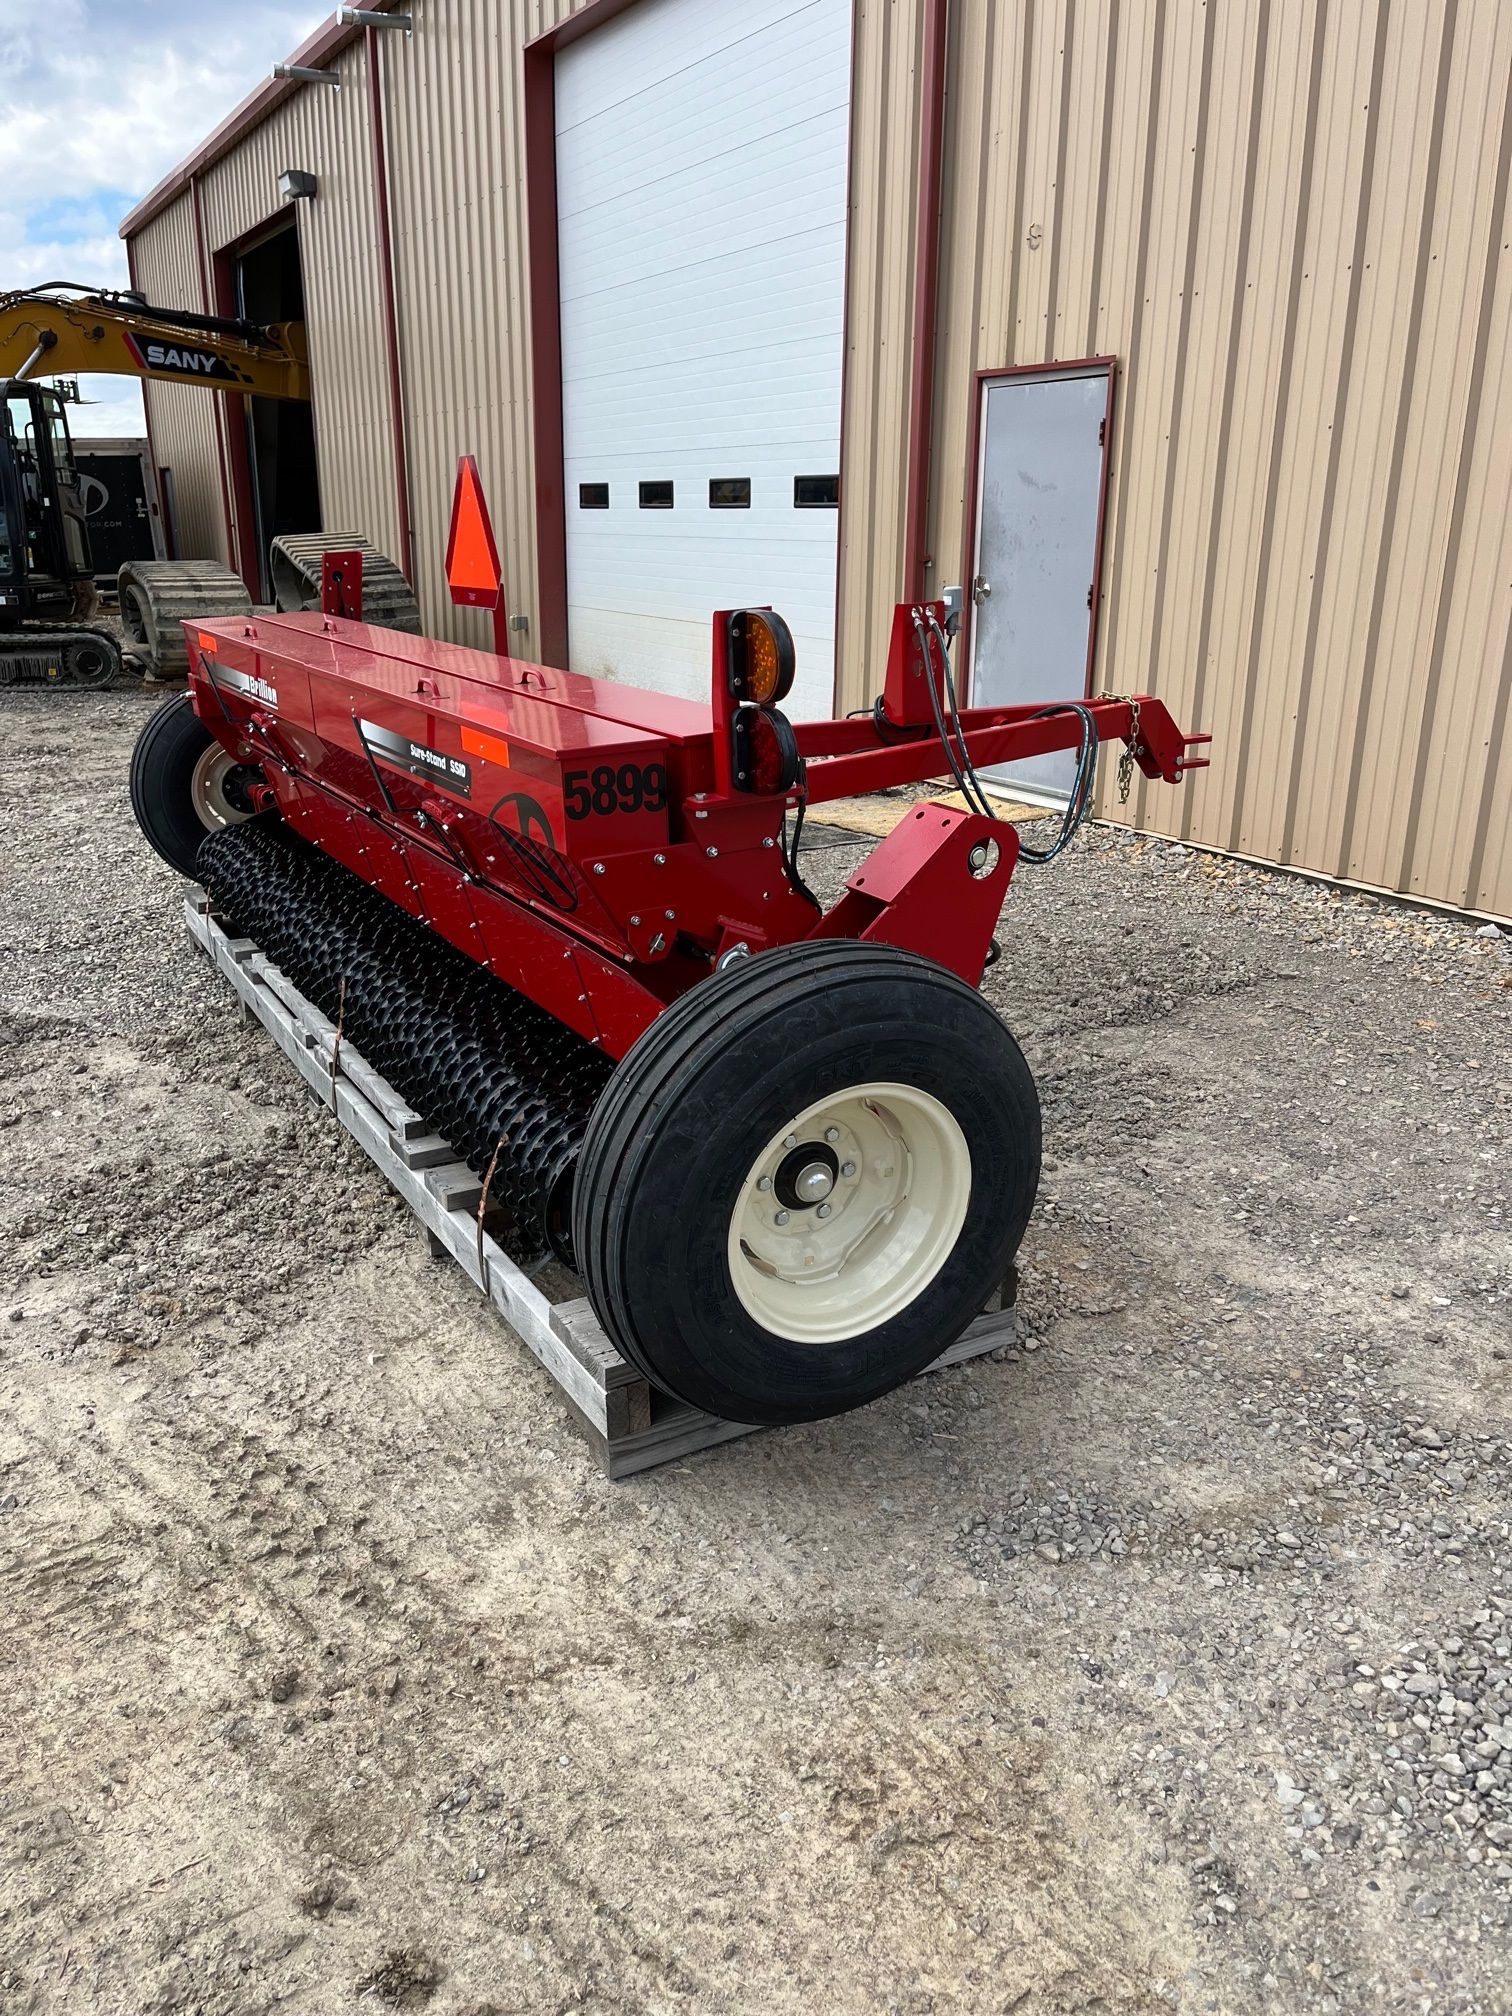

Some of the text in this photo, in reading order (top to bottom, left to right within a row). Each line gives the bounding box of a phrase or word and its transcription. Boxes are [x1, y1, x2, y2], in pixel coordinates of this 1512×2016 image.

[147, 345, 217, 373] SANY
[249, 675, 278, 704] Brillion
[410, 743, 447, 770] Sure-Stand
[564, 763, 667, 821] 5899
